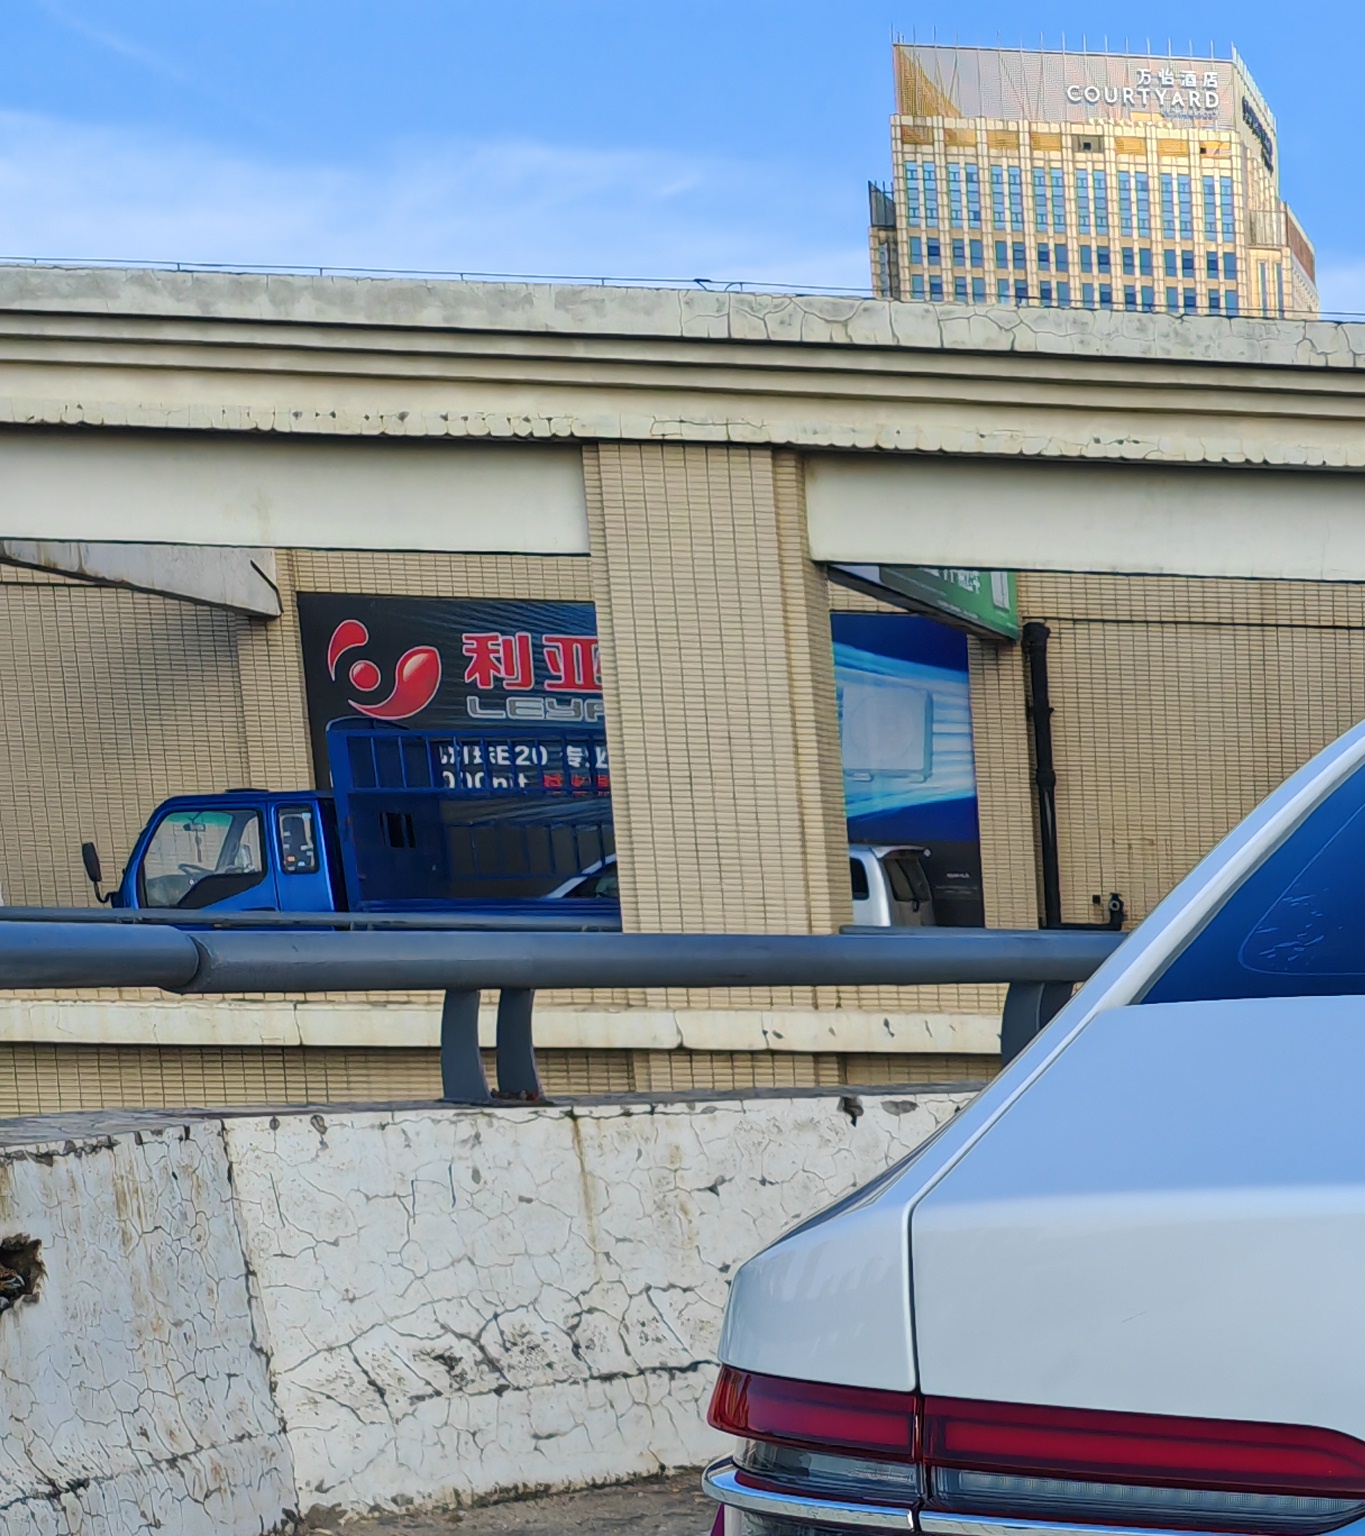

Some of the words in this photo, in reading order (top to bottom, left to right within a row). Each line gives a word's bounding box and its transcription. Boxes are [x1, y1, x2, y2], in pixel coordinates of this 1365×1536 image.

[1137, 68, 1219, 88] 万怡酒店
[1067, 84, 1220, 109] COURTYARD
[462, 632, 603, 692] 利亚
